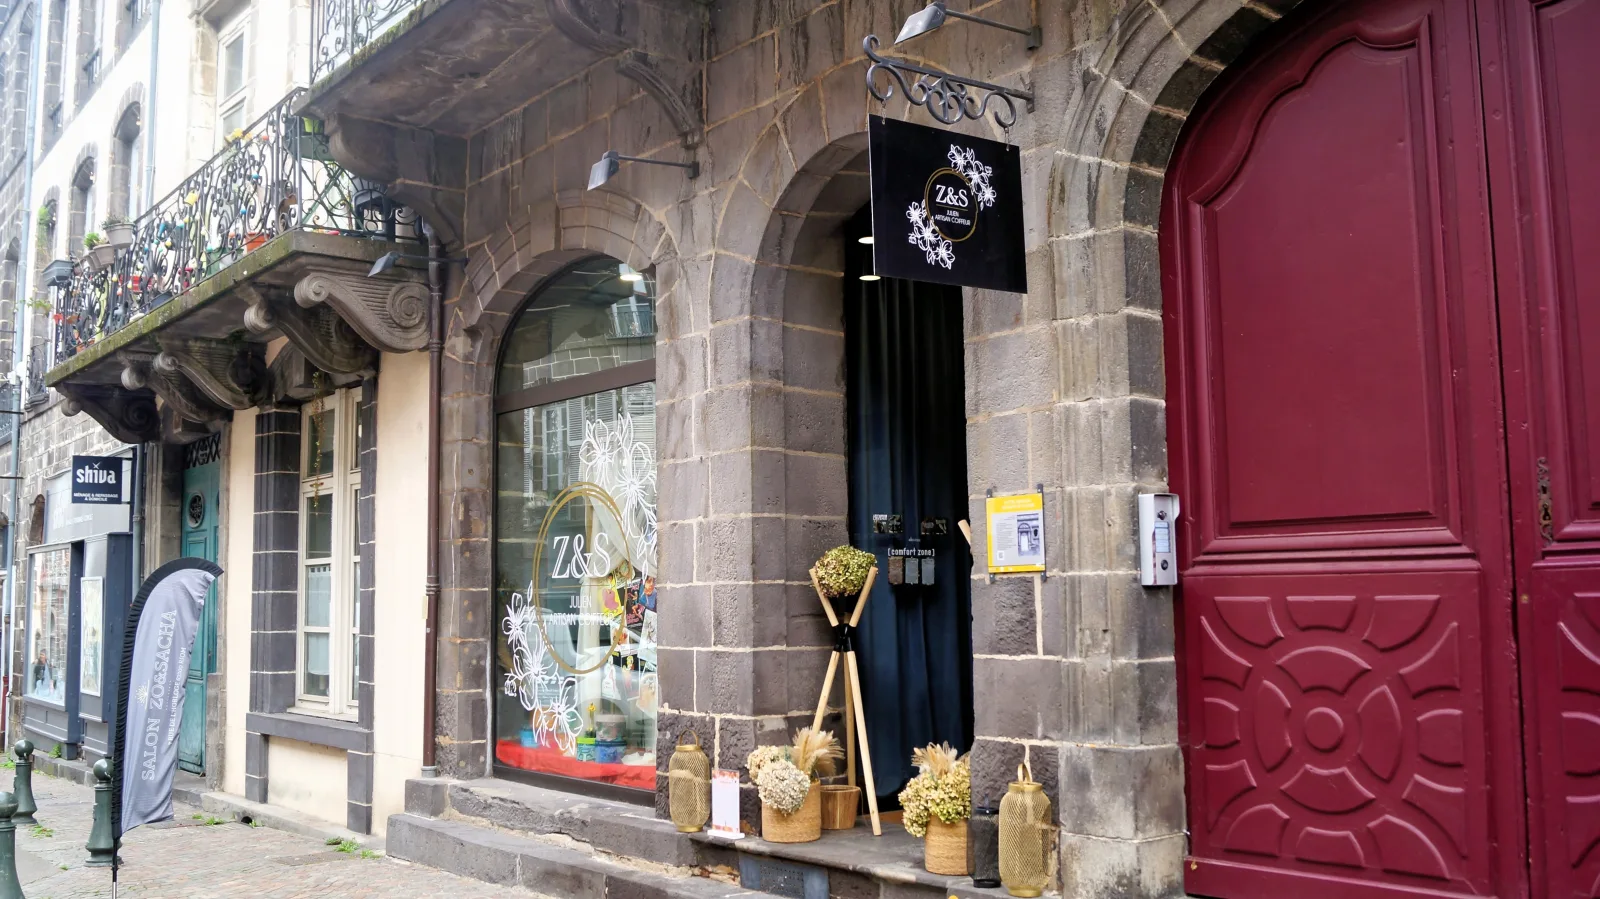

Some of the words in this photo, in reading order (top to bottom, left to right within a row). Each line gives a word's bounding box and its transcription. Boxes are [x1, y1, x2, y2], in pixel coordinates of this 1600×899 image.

[935, 184, 969, 207] Z&S
[934, 214, 951, 222] ARTISAN
[951, 217, 971, 225] COIFFEUR
[946, 209, 960, 217] JULIEN
[76, 465, 116, 484] shiva
[551, 532, 611, 579] Z&S
[569, 595, 592, 608] JULIEN
[549, 612, 576, 626] ARTISAN
[578, 612, 615, 626] COIFFEUR
[149, 609, 177, 710] ZO&SACHA
[177, 647, 187, 665] RIOM
[169, 717, 176, 727] DE
[167, 727, 175, 741] RUE
[141, 717, 161, 781] SALON
